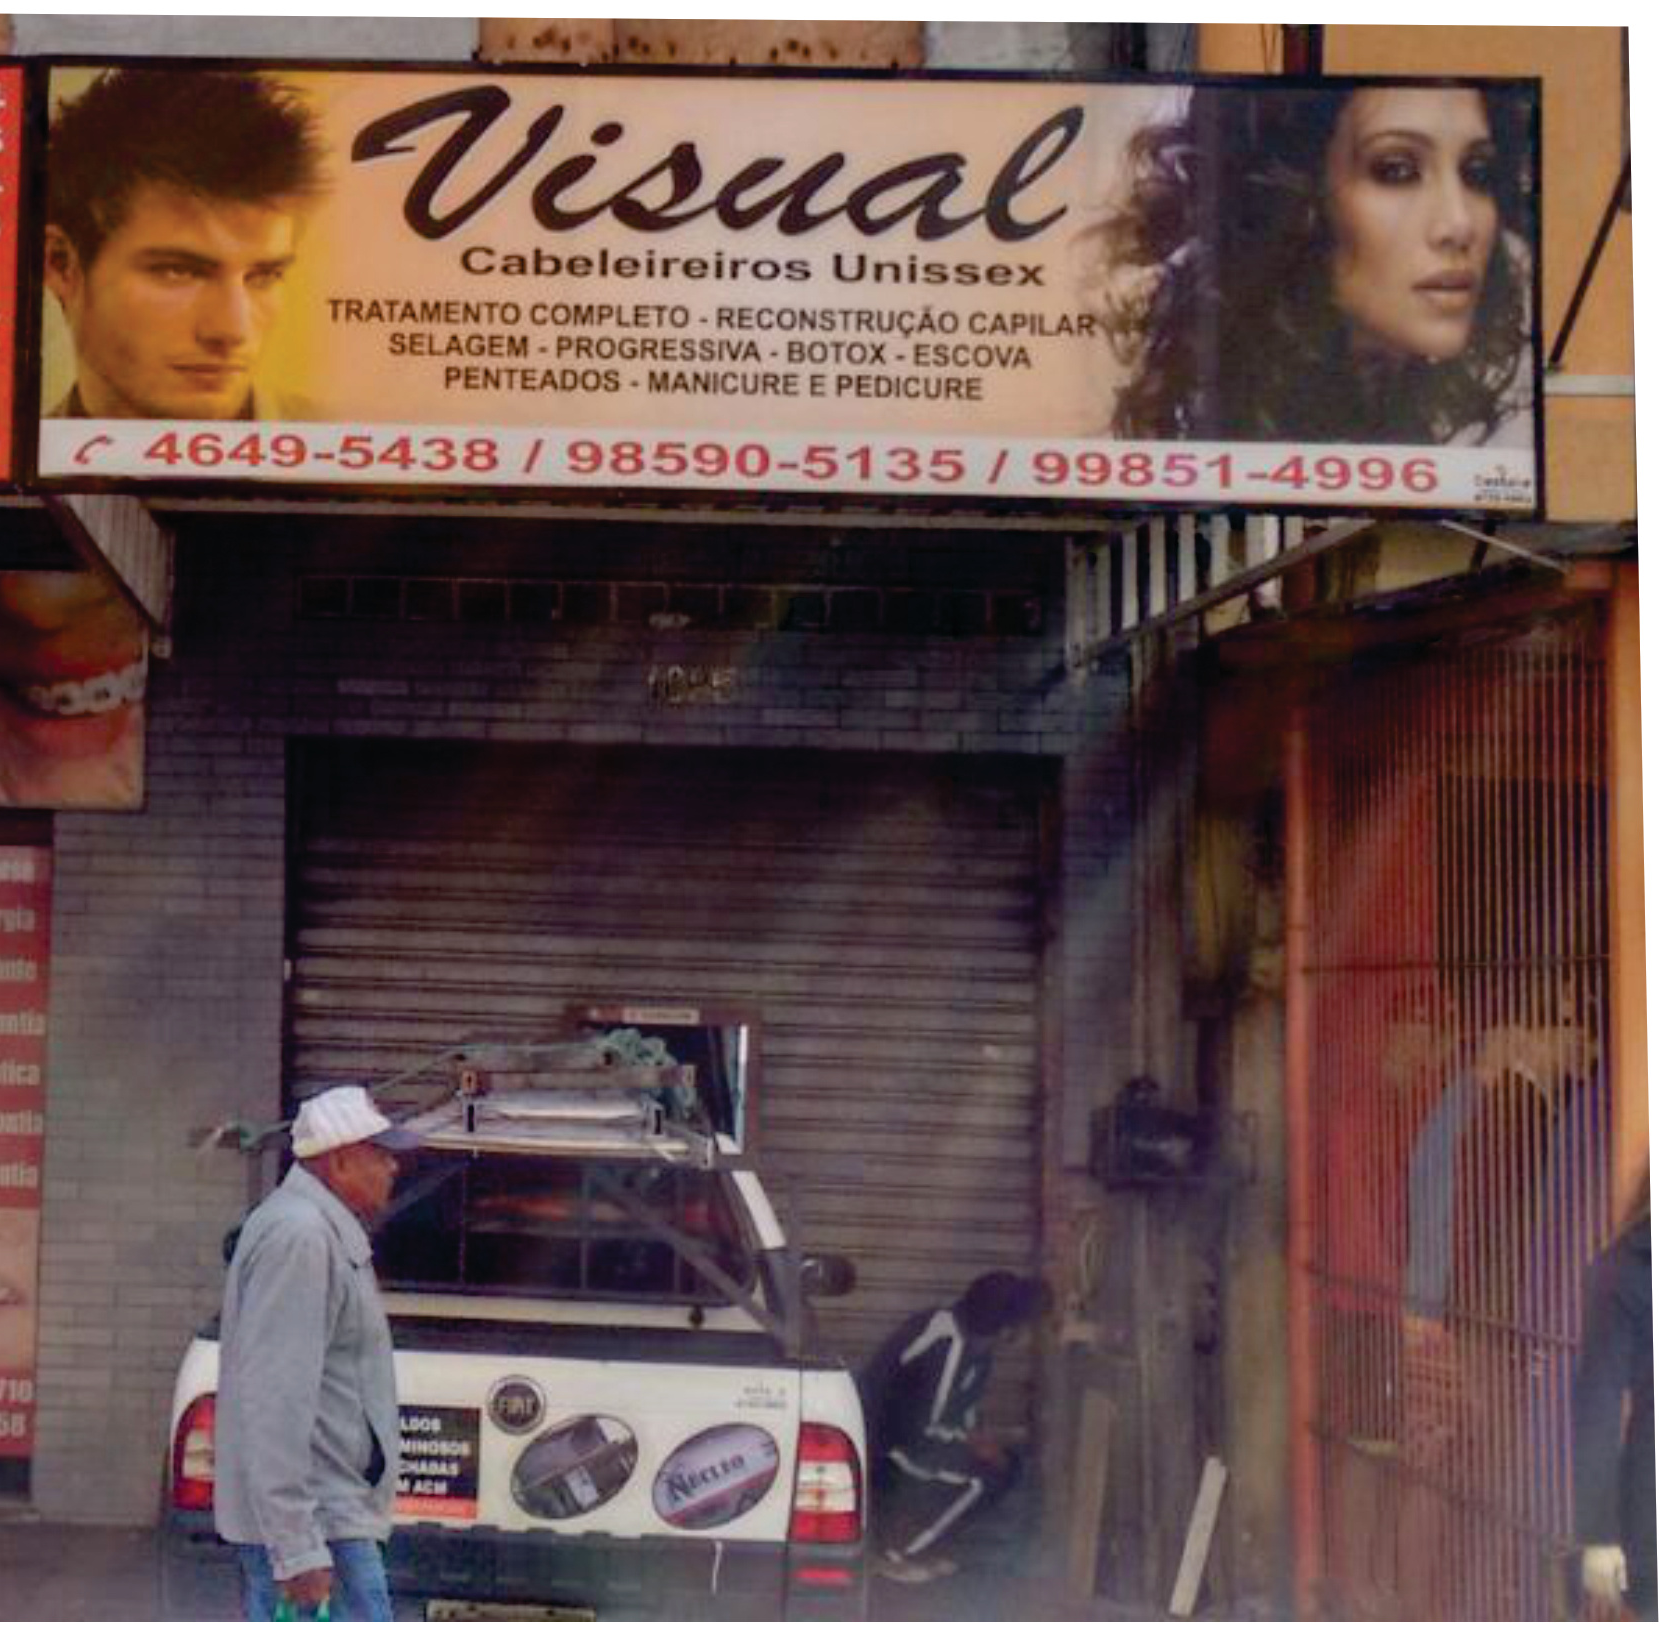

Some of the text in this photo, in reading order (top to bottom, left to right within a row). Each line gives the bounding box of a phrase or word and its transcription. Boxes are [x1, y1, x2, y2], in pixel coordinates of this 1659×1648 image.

[351, 84, 1085, 242] Visual
[460, 246, 1046, 287] Cabeleireiros Unissex
[327, 298, 521, 325] TRATAMENTO
[530, 302, 689, 329] COMPLETO
[716, 304, 960, 338] RECONSTRUÇÃO
[968, 311, 1097, 338] CAPILAR
[387, 332, 529, 358] SELAGEM
[555, 336, 761, 363] PROGRESSIVA
[786, 340, 887, 366] BOTOX
[913, 343, 1032, 369] ESCOVA
[444, 366, 621, 393] PENTEADOS
[647, 370, 800, 397] MANICURE
[810, 374, 826, 398] E
[836, 375, 984, 401] PEDICURE
[143, 431, 499, 472] 4649-5438
[566, 440, 965, 484] 98590-5135
[1032, 450, 1438, 493] 99851-4996
[399, 1415, 442, 1433] LDOS
[398, 1438, 472, 1459] MINOSOS
[398, 1458, 462, 1478] CHADAS
